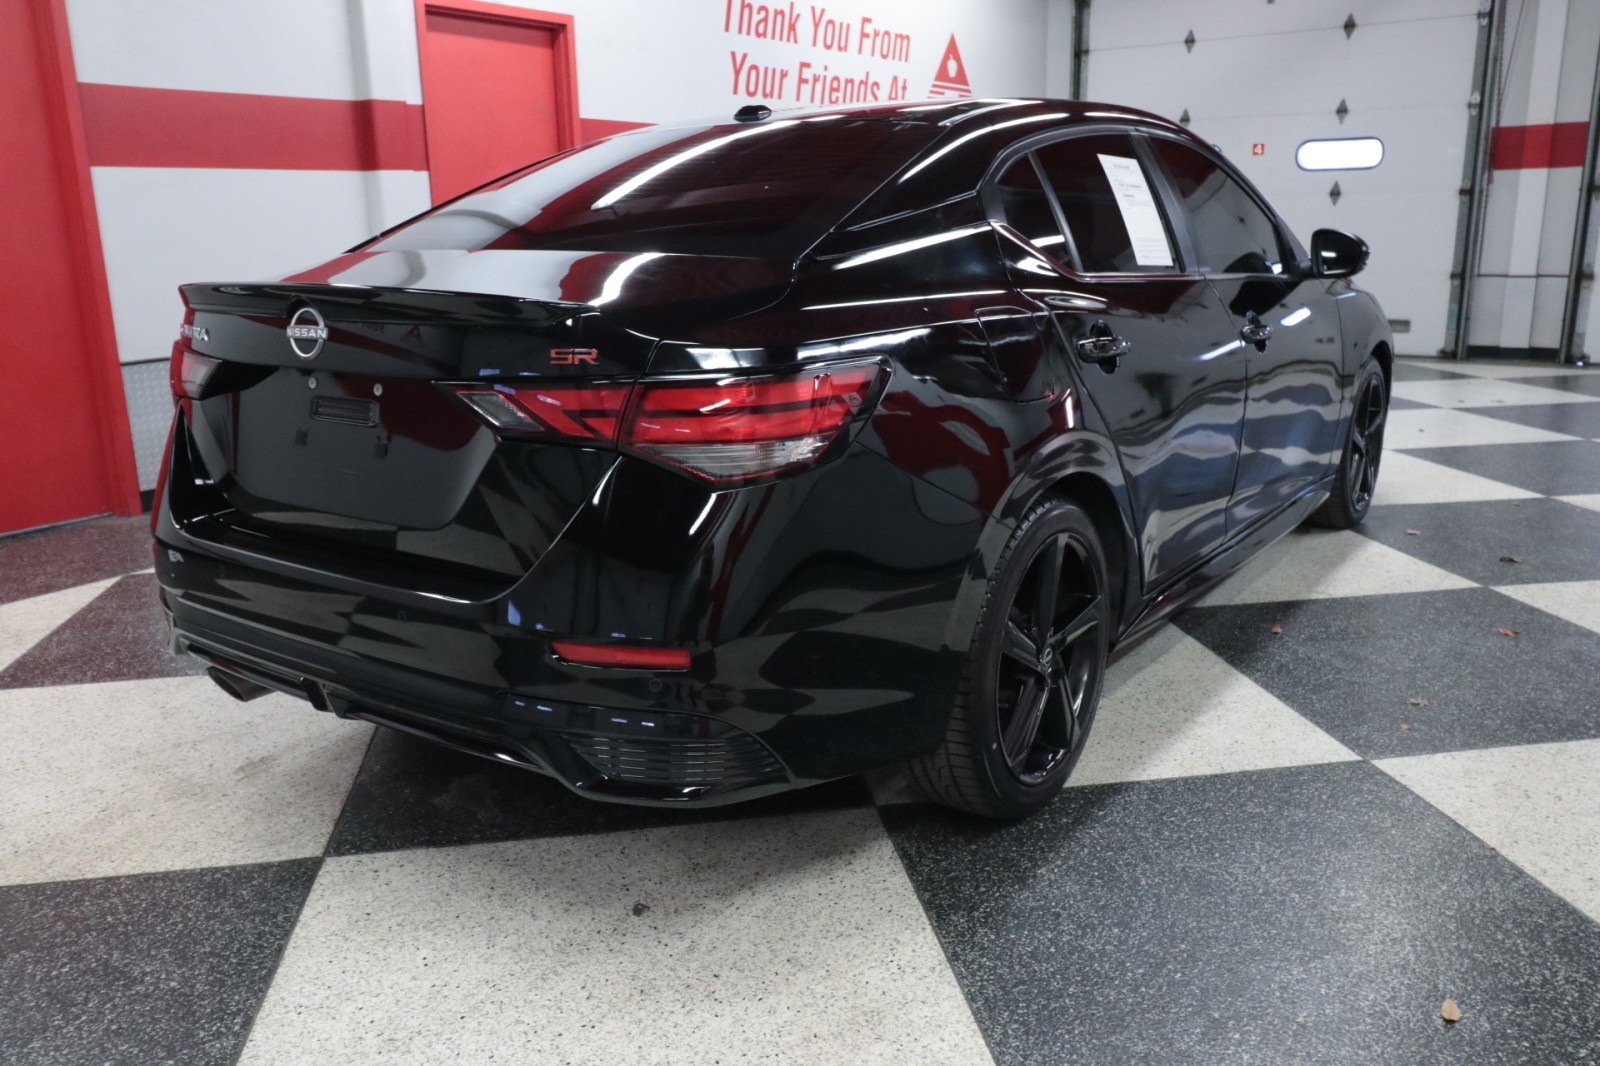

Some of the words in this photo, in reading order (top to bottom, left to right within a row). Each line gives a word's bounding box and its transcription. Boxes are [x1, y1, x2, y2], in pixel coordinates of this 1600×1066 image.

[724, 0, 801, 44] Thank
[810, 6, 850, 53] You
[857, 16, 911, 63] From
[730, 50, 788, 100] Your
[796, 61, 880, 104] Friends
[888, 75, 908, 101] At
[1253, 143, 1263, 155] 4
[550, 348, 599, 365] SR
